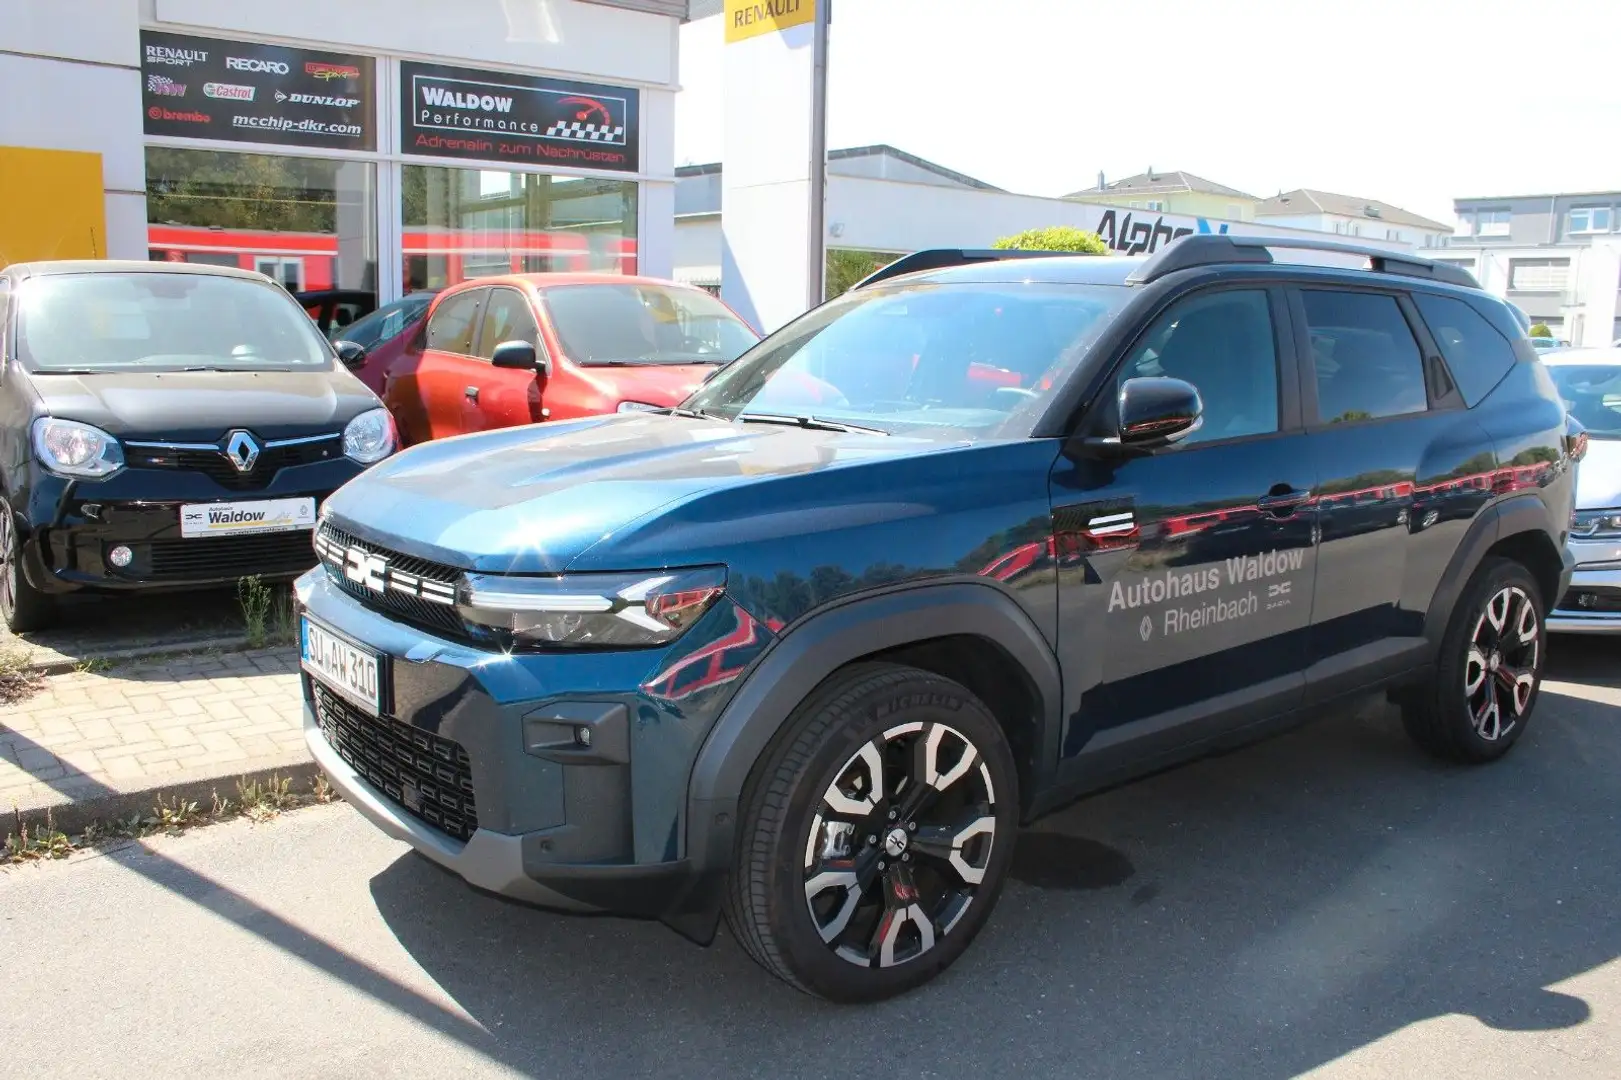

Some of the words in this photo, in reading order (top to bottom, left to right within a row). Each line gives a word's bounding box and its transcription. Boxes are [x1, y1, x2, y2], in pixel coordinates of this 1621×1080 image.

[146, 45, 208, 61] RENAULT
[147, 56, 193, 66] SPORT
[226, 57, 289, 75] RECARO
[216, 85, 251, 99] Castrol
[288, 93, 360, 107] DUNLOP
[421, 86, 512, 113] WALDOW
[163, 107, 211, 123] brembo
[421, 109, 539, 133] Performance
[232, 115, 361, 135] mcchip-dkr.com
[415, 133, 493, 151] Adrenalin
[498, 144, 531, 156] zum
[208, 510, 265, 524] Waldow
[1107, 565, 1220, 613] Autohaus
[1226, 548, 1304, 585] Waldow
[1164, 591, 1258, 636] Rheinbach
[308, 627, 324, 666] SU
[331, 637, 347, 680] AW
[349, 653, 376, 700] 310
